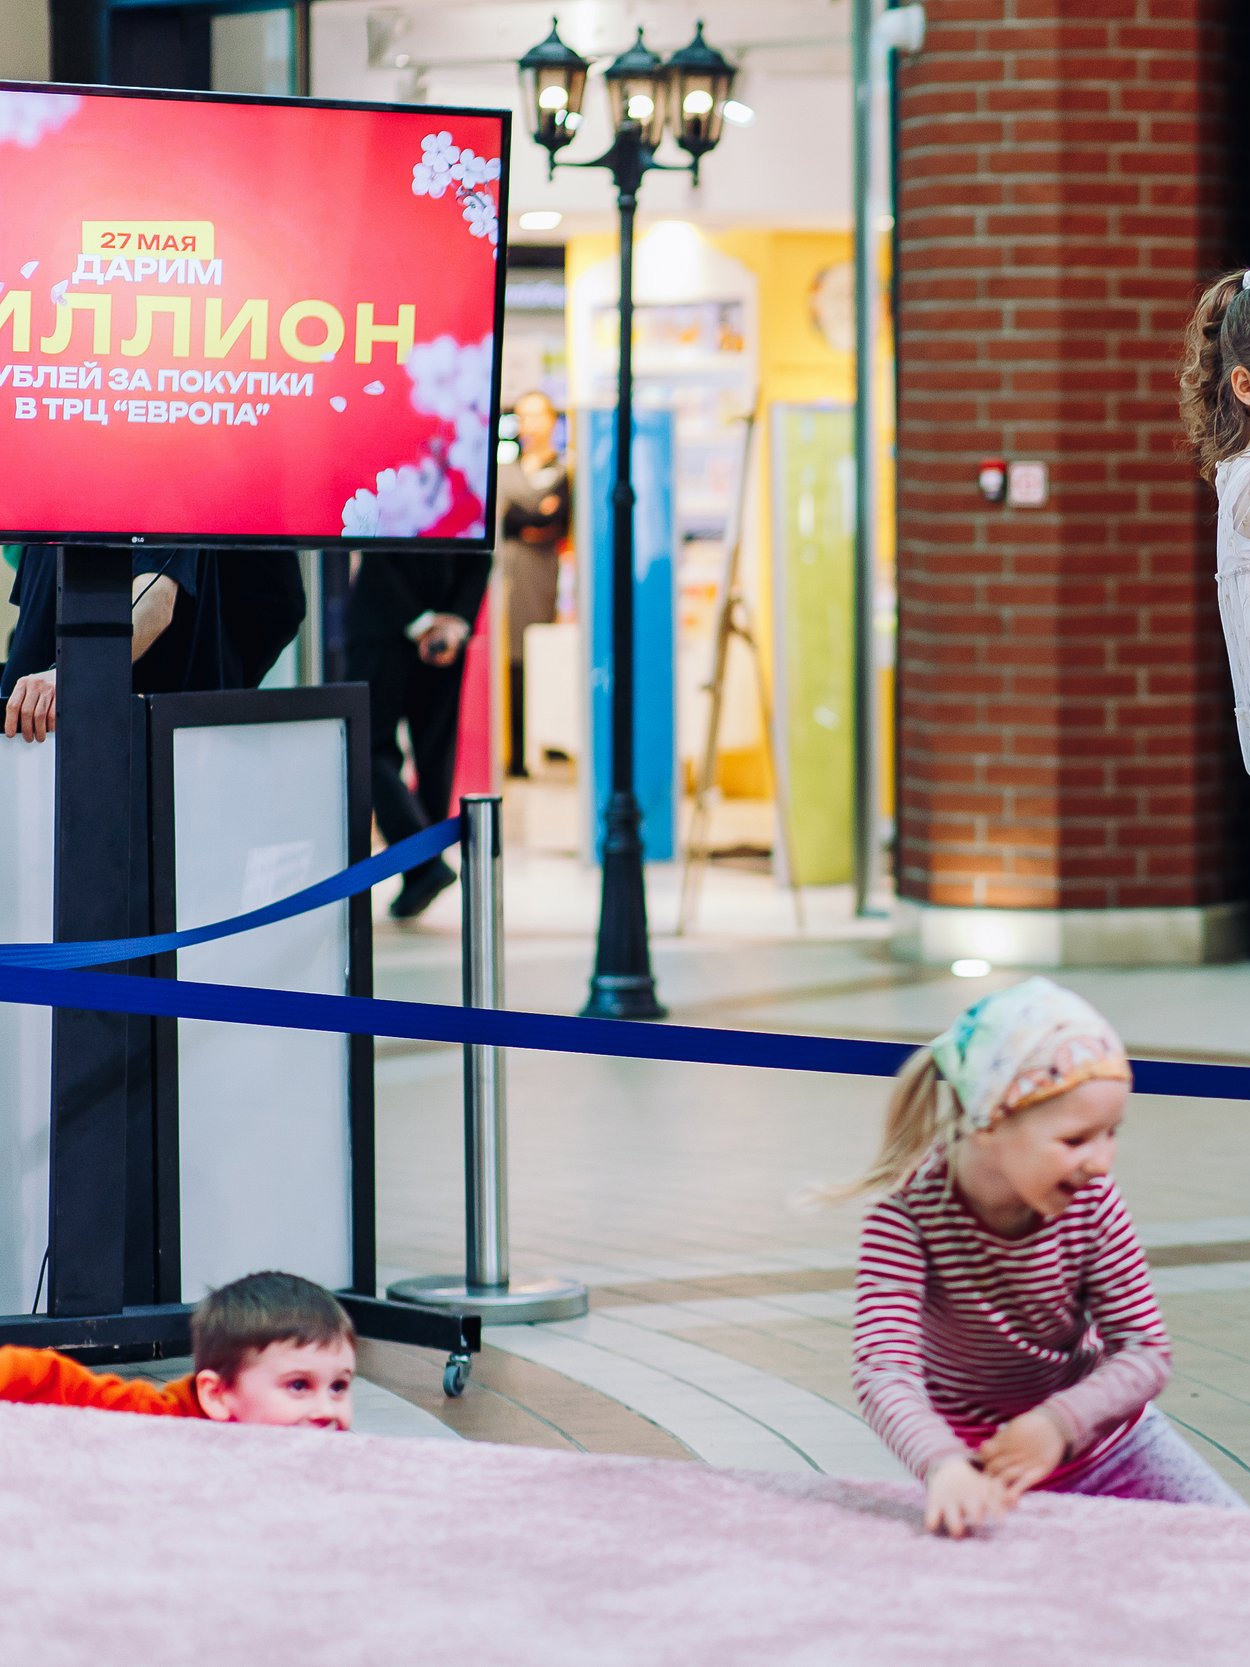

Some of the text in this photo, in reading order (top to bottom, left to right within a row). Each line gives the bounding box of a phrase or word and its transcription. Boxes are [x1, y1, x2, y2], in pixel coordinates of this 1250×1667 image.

[100, 231, 197, 252] 27 МАЯ
[71, 253, 223, 286] ДАРИМ
[108, 367, 152, 391] ЗА
[157, 369, 315, 397] ПОКУПКИ
[15, 397, 37, 419] В
[42, 397, 109, 426] ТРЦ
